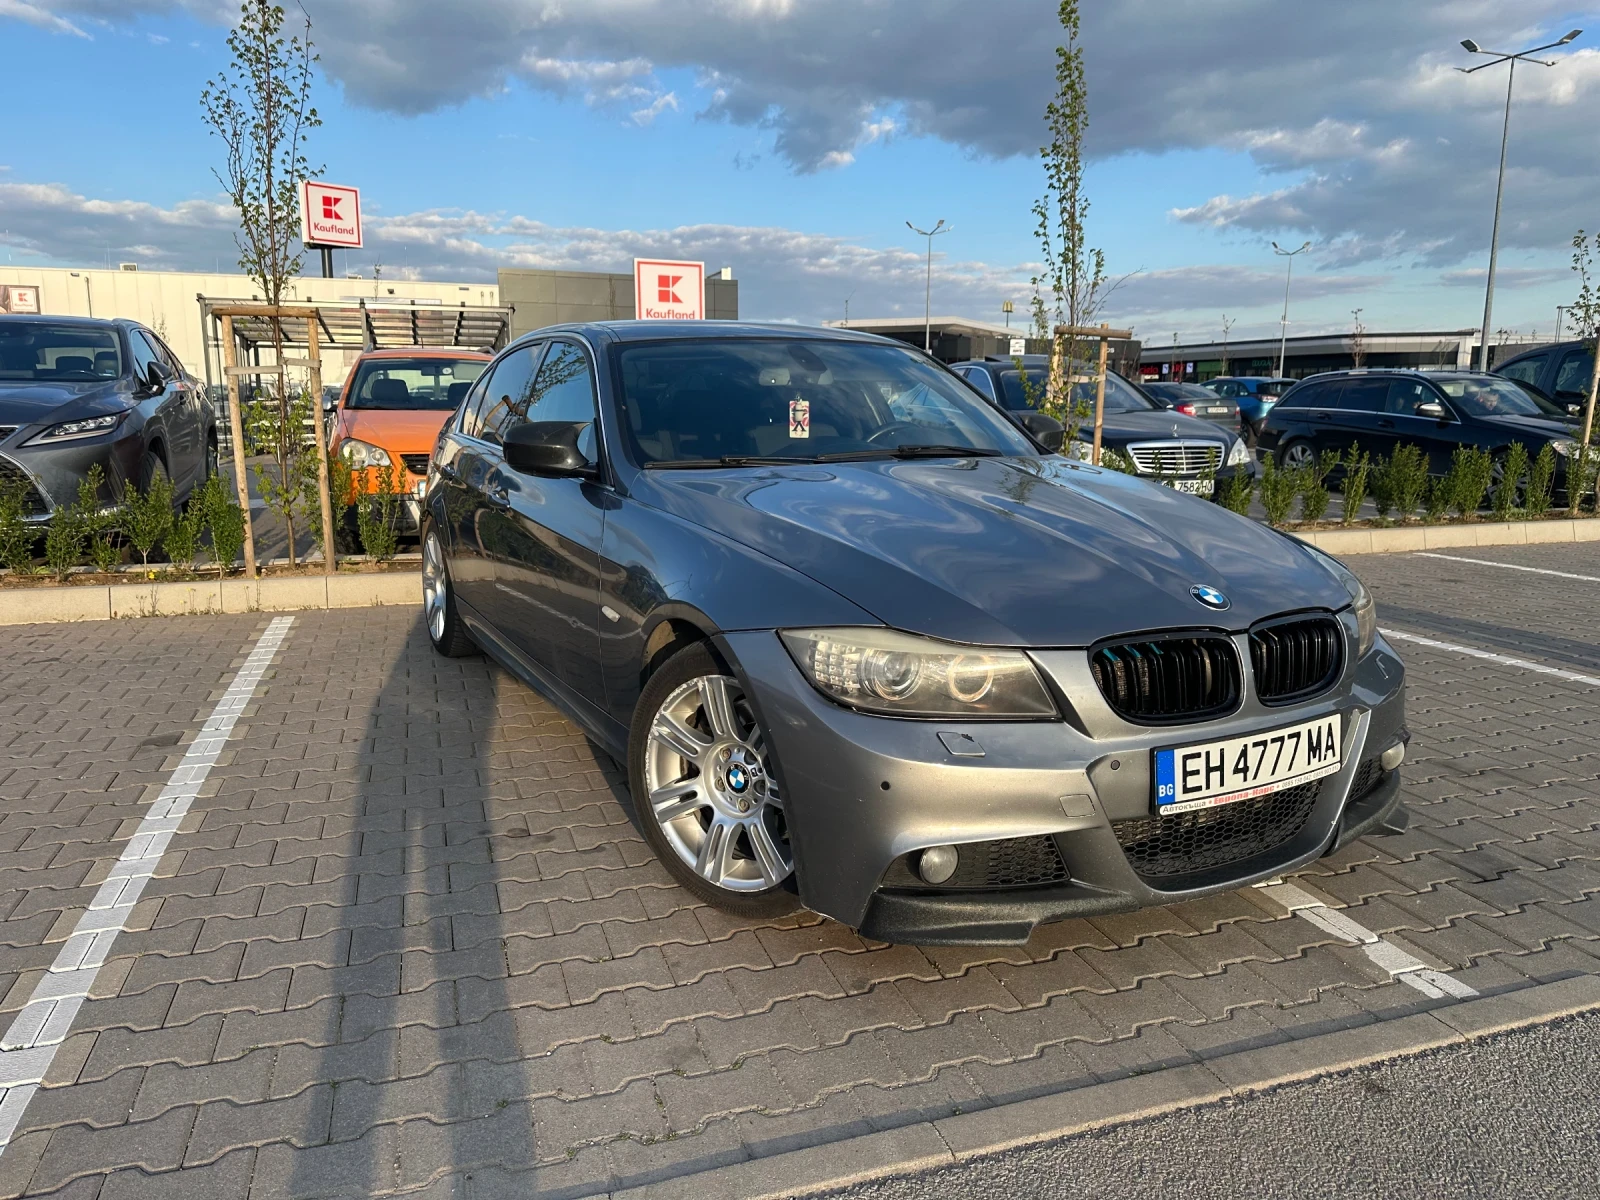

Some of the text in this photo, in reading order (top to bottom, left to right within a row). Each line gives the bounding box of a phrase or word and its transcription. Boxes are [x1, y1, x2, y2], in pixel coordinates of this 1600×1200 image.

[313, 222, 355, 236] Kaufland
[646, 307, 695, 320] Kaufland
[1182, 722, 1337, 795] EH 4777 MA
[1159, 783, 1174, 797] BG
[1162, 800, 1207, 813] Автокъща
